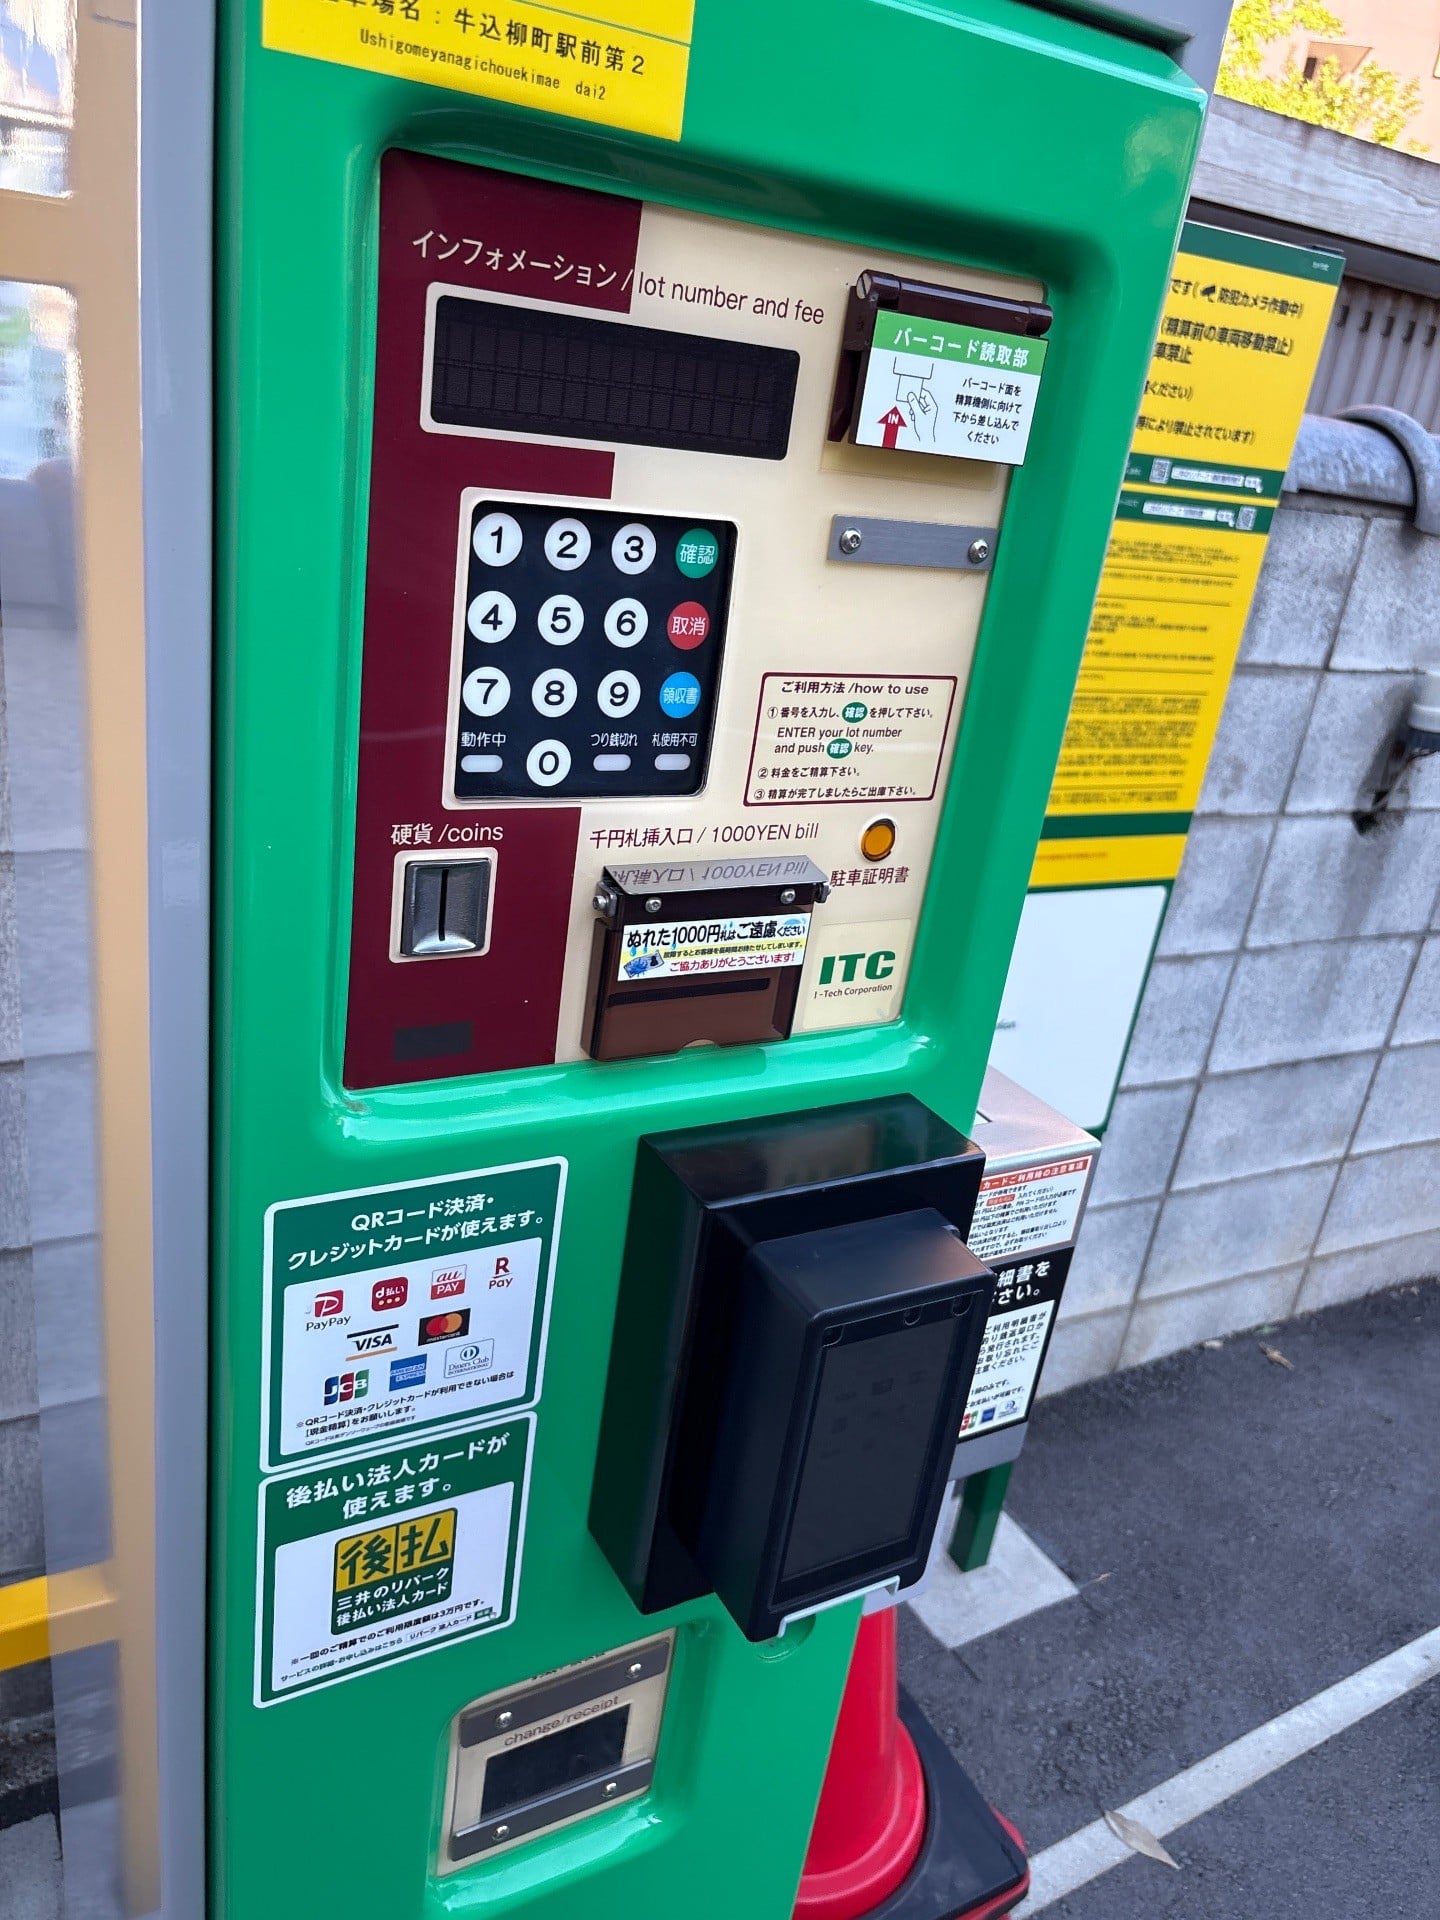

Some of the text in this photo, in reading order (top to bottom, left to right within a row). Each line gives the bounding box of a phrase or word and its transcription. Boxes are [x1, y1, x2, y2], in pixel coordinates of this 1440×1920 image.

[359, 29, 606, 101] Ushigomeyanagichouekimae dai2
[412, 230, 618, 289] インフォメーション
[638, 271, 667, 298] lot
[672, 281, 748, 312] number
[752, 297, 789, 319] and
[795, 298, 825, 325] fee
[893, 327, 1030, 369] バーコード読取部
[962, 377, 1022, 397] バーコード面を
[954, 394, 1022, 415] 精算機側に向けて
[886, 413, 899, 425] IN
[952, 411, 1019, 432] 下から差し込んで
[966, 431, 1000, 445] ください
[490, 526, 645, 563] 1 2 3
[679, 543, 715, 566] 確認
[480, 604, 637, 636] 4 5 6
[671, 616, 706, 636] 取消
[476, 678, 629, 707] 7 8 9
[663, 687, 699, 706] 領収書
[781, 681, 845, 694] ご利用方法
[887, 684, 901, 694] to
[905, 685, 929, 695] use
[869, 706, 933, 719] を押して下さい。
[460, 731, 507, 748] 動作中
[590, 732, 639, 748] つり銭切れ
[651, 732, 698, 748] 札使用不可
[777, 727, 902, 740] ENTER your lot number
[774, 743, 796, 754] and
[797, 743, 825, 756] push
[854, 742, 874, 755] key.
[538, 750, 560, 776] 0
[390, 823, 434, 845] 硬貨
[589, 827, 694, 849] 千円札挿入口
[711, 825, 791, 843] 1000YEN
[794, 822, 820, 840] bill
[830, 867, 910, 887] 駐車証明書
[819, 950, 896, 985] ITC
[844, 984, 893, 996] Corporation
[286, 1209, 545, 1271] クレジットカードが使えます。
[494, 1256, 511, 1275] R
[436, 1270, 463, 1283] au
[488, 1277, 513, 1290] Pay
[375, 1285, 406, 1299] d払い
[436, 1282, 460, 1295] PAY
[992, 1282, 1041, 1306] さい。
[306, 1315, 352, 1332] PayPay
[354, 1332, 393, 1352] VISA
[448, 1356, 491, 1373] Diners Club
[324, 1372, 369, 1401] JCB
[285, 1431, 512, 1509] 後払い法人カードが
[342, 1478, 452, 1520] 使えます。
[339, 1517, 451, 1587] 後払
[336, 1567, 450, 1612] 三井のリパーク
[335, 1581, 450, 1627] 後払い法人カード
[503, 1695, 620, 1748] change/receipt
